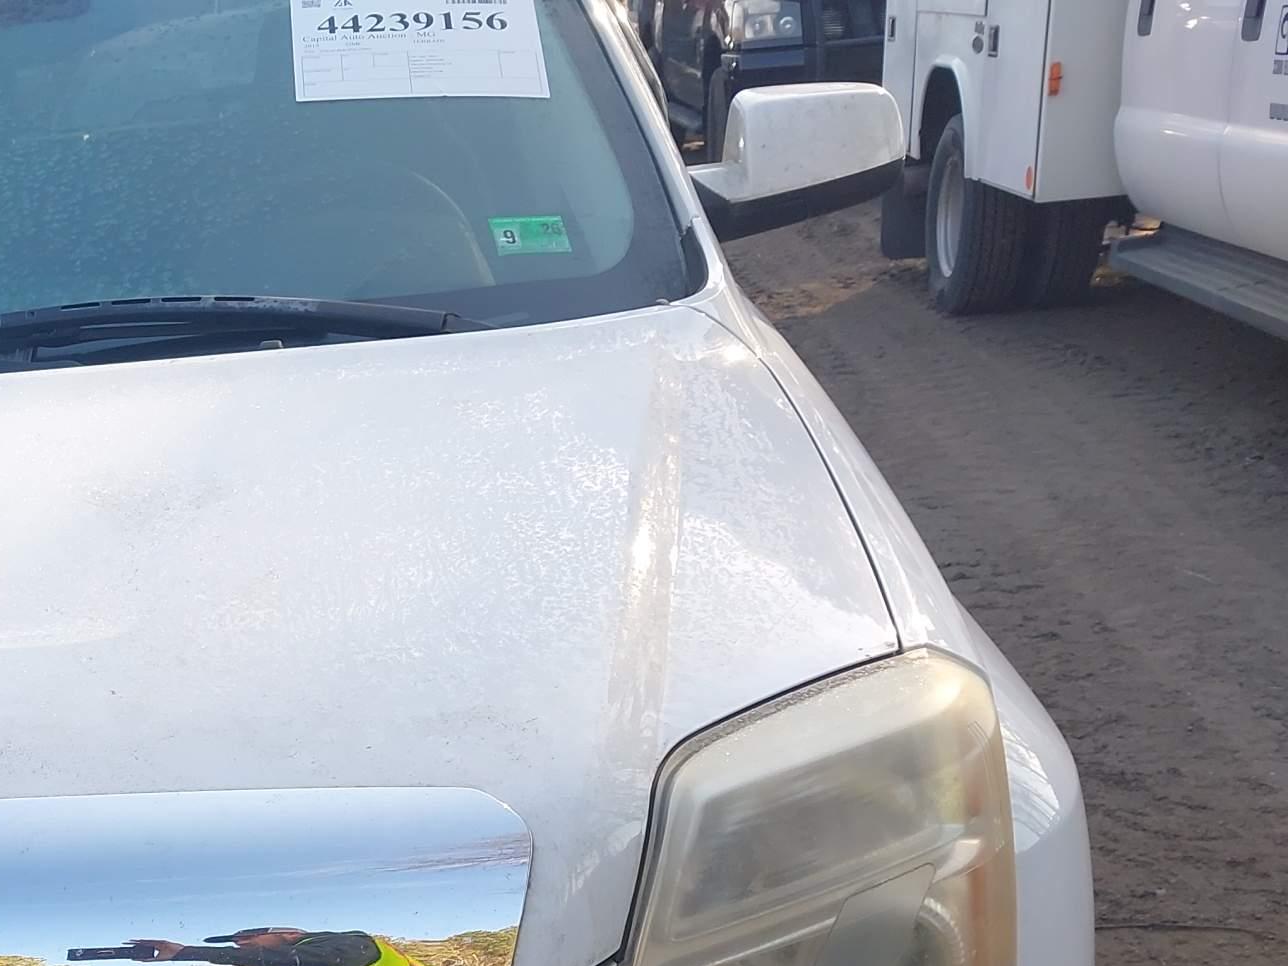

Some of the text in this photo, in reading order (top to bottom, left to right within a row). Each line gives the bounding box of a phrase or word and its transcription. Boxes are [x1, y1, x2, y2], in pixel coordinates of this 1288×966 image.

[317, 11, 508, 34] 44239156
[302, 35, 337, 43] Capital
[367, 32, 407, 40] Auction
[503, 229, 517, 245] 9
